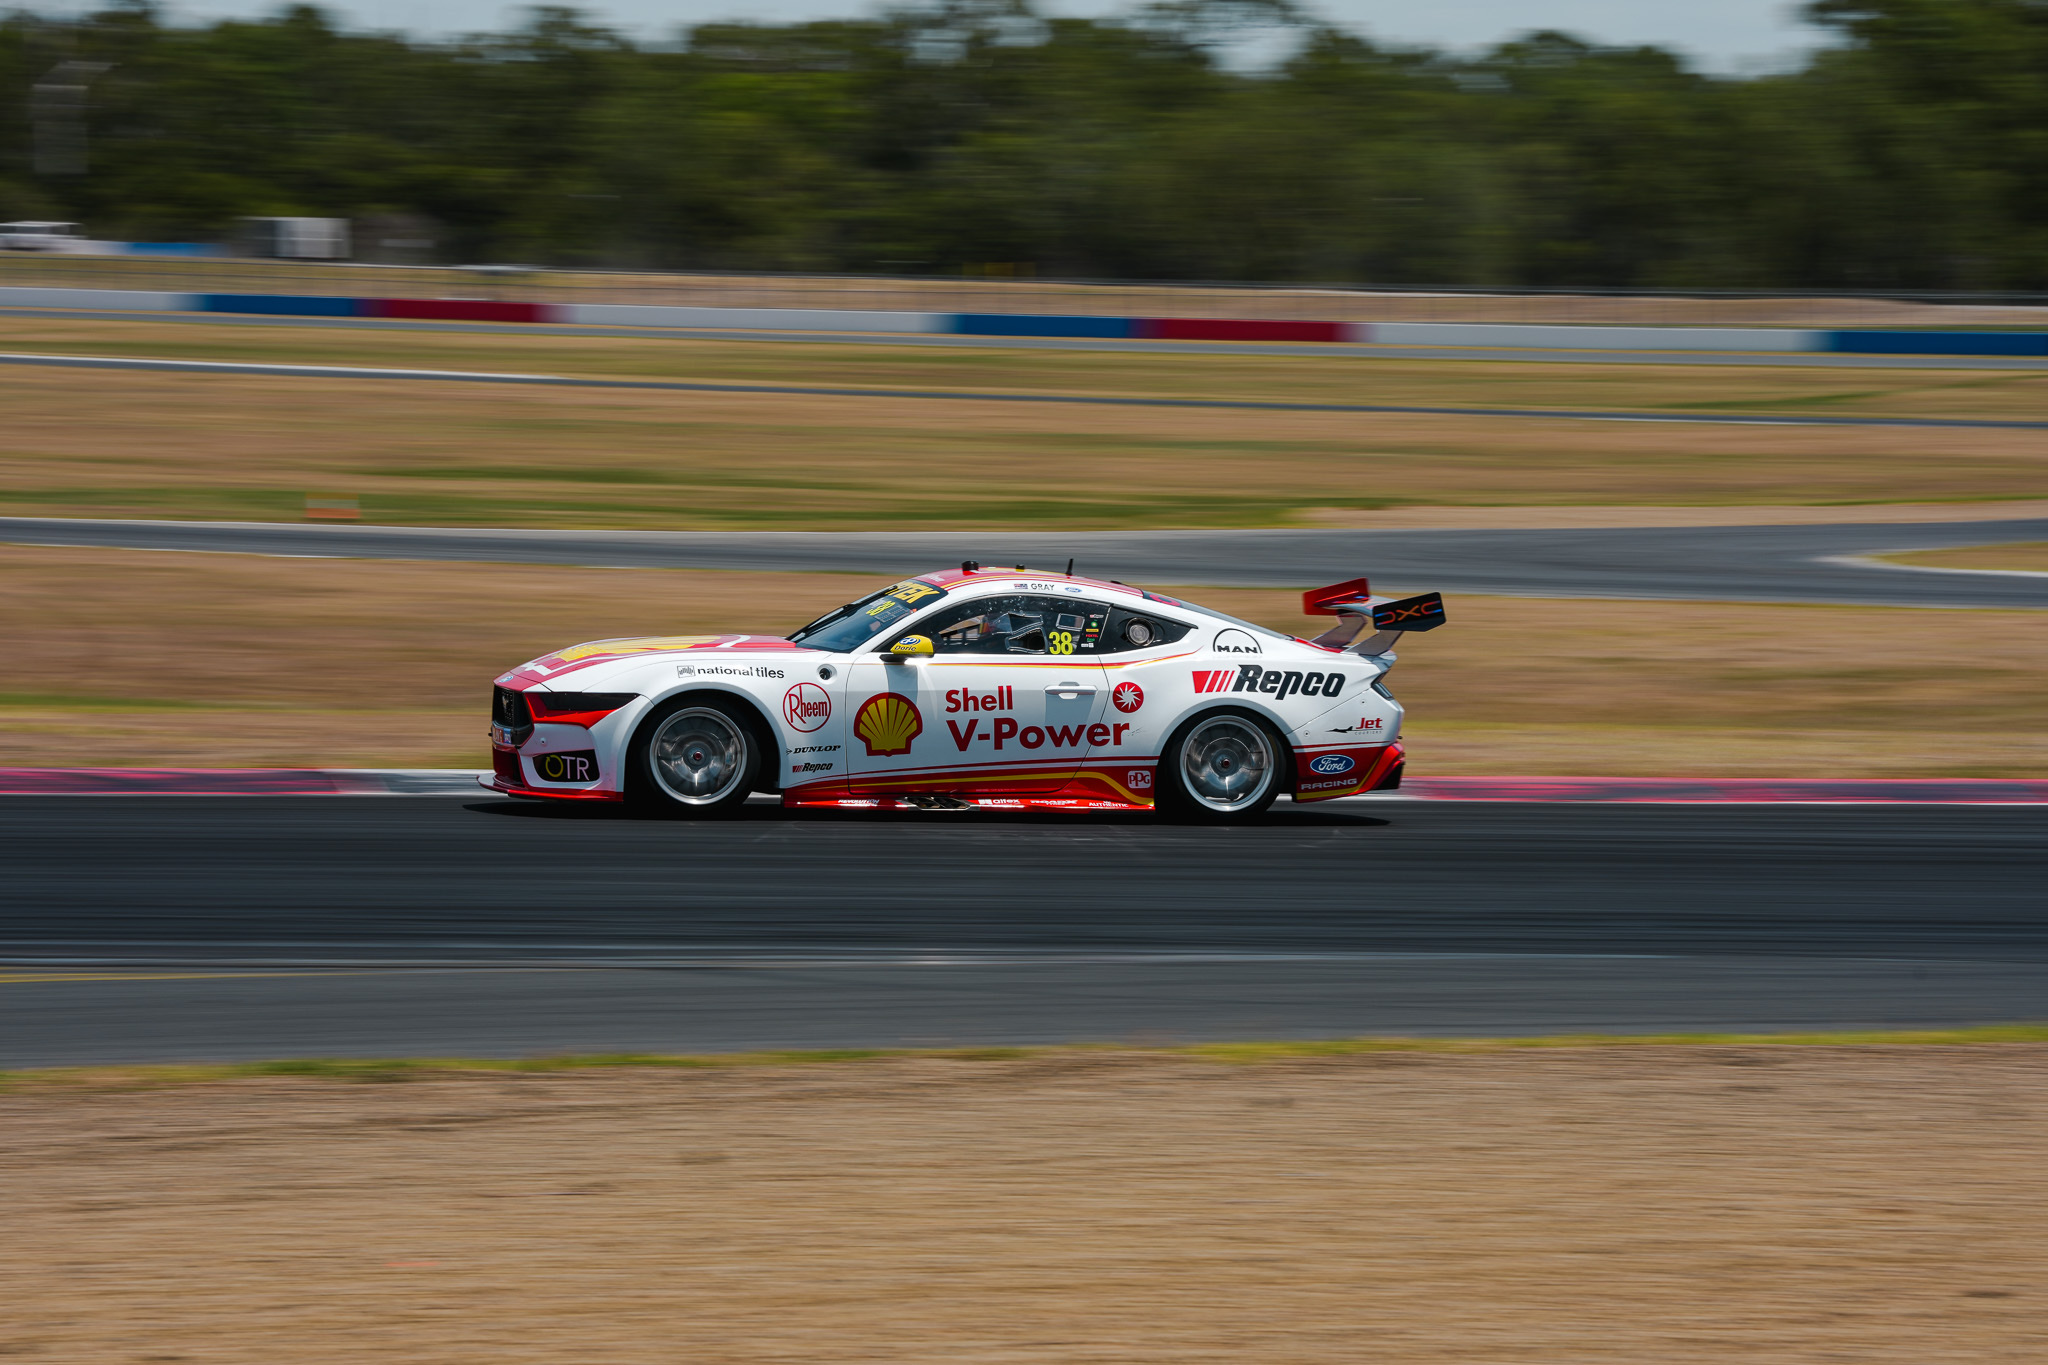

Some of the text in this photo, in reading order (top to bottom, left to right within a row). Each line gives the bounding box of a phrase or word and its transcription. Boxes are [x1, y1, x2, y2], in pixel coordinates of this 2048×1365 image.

[1031, 583, 1054, 591] GRAY
[1374, 601, 1442, 626] DXC
[1049, 631, 1073, 655] 38
[1216, 645, 1258, 654] MAN
[697, 666, 785, 679] national tiles
[1231, 664, 1346, 700] Repco
[788, 685, 828, 724] Rheem
[945, 685, 1014, 713] Shell
[1356, 717, 1383, 729] Jet
[946, 718, 1130, 752] V-Power
[794, 745, 841, 754] DUNLOP
[545, 754, 590, 781] OTR
[801, 763, 833, 774] Repco
[1318, 757, 1346, 771] Ford
[1129, 771, 1150, 787] PPG
[1301, 778, 1358, 790] RACING
